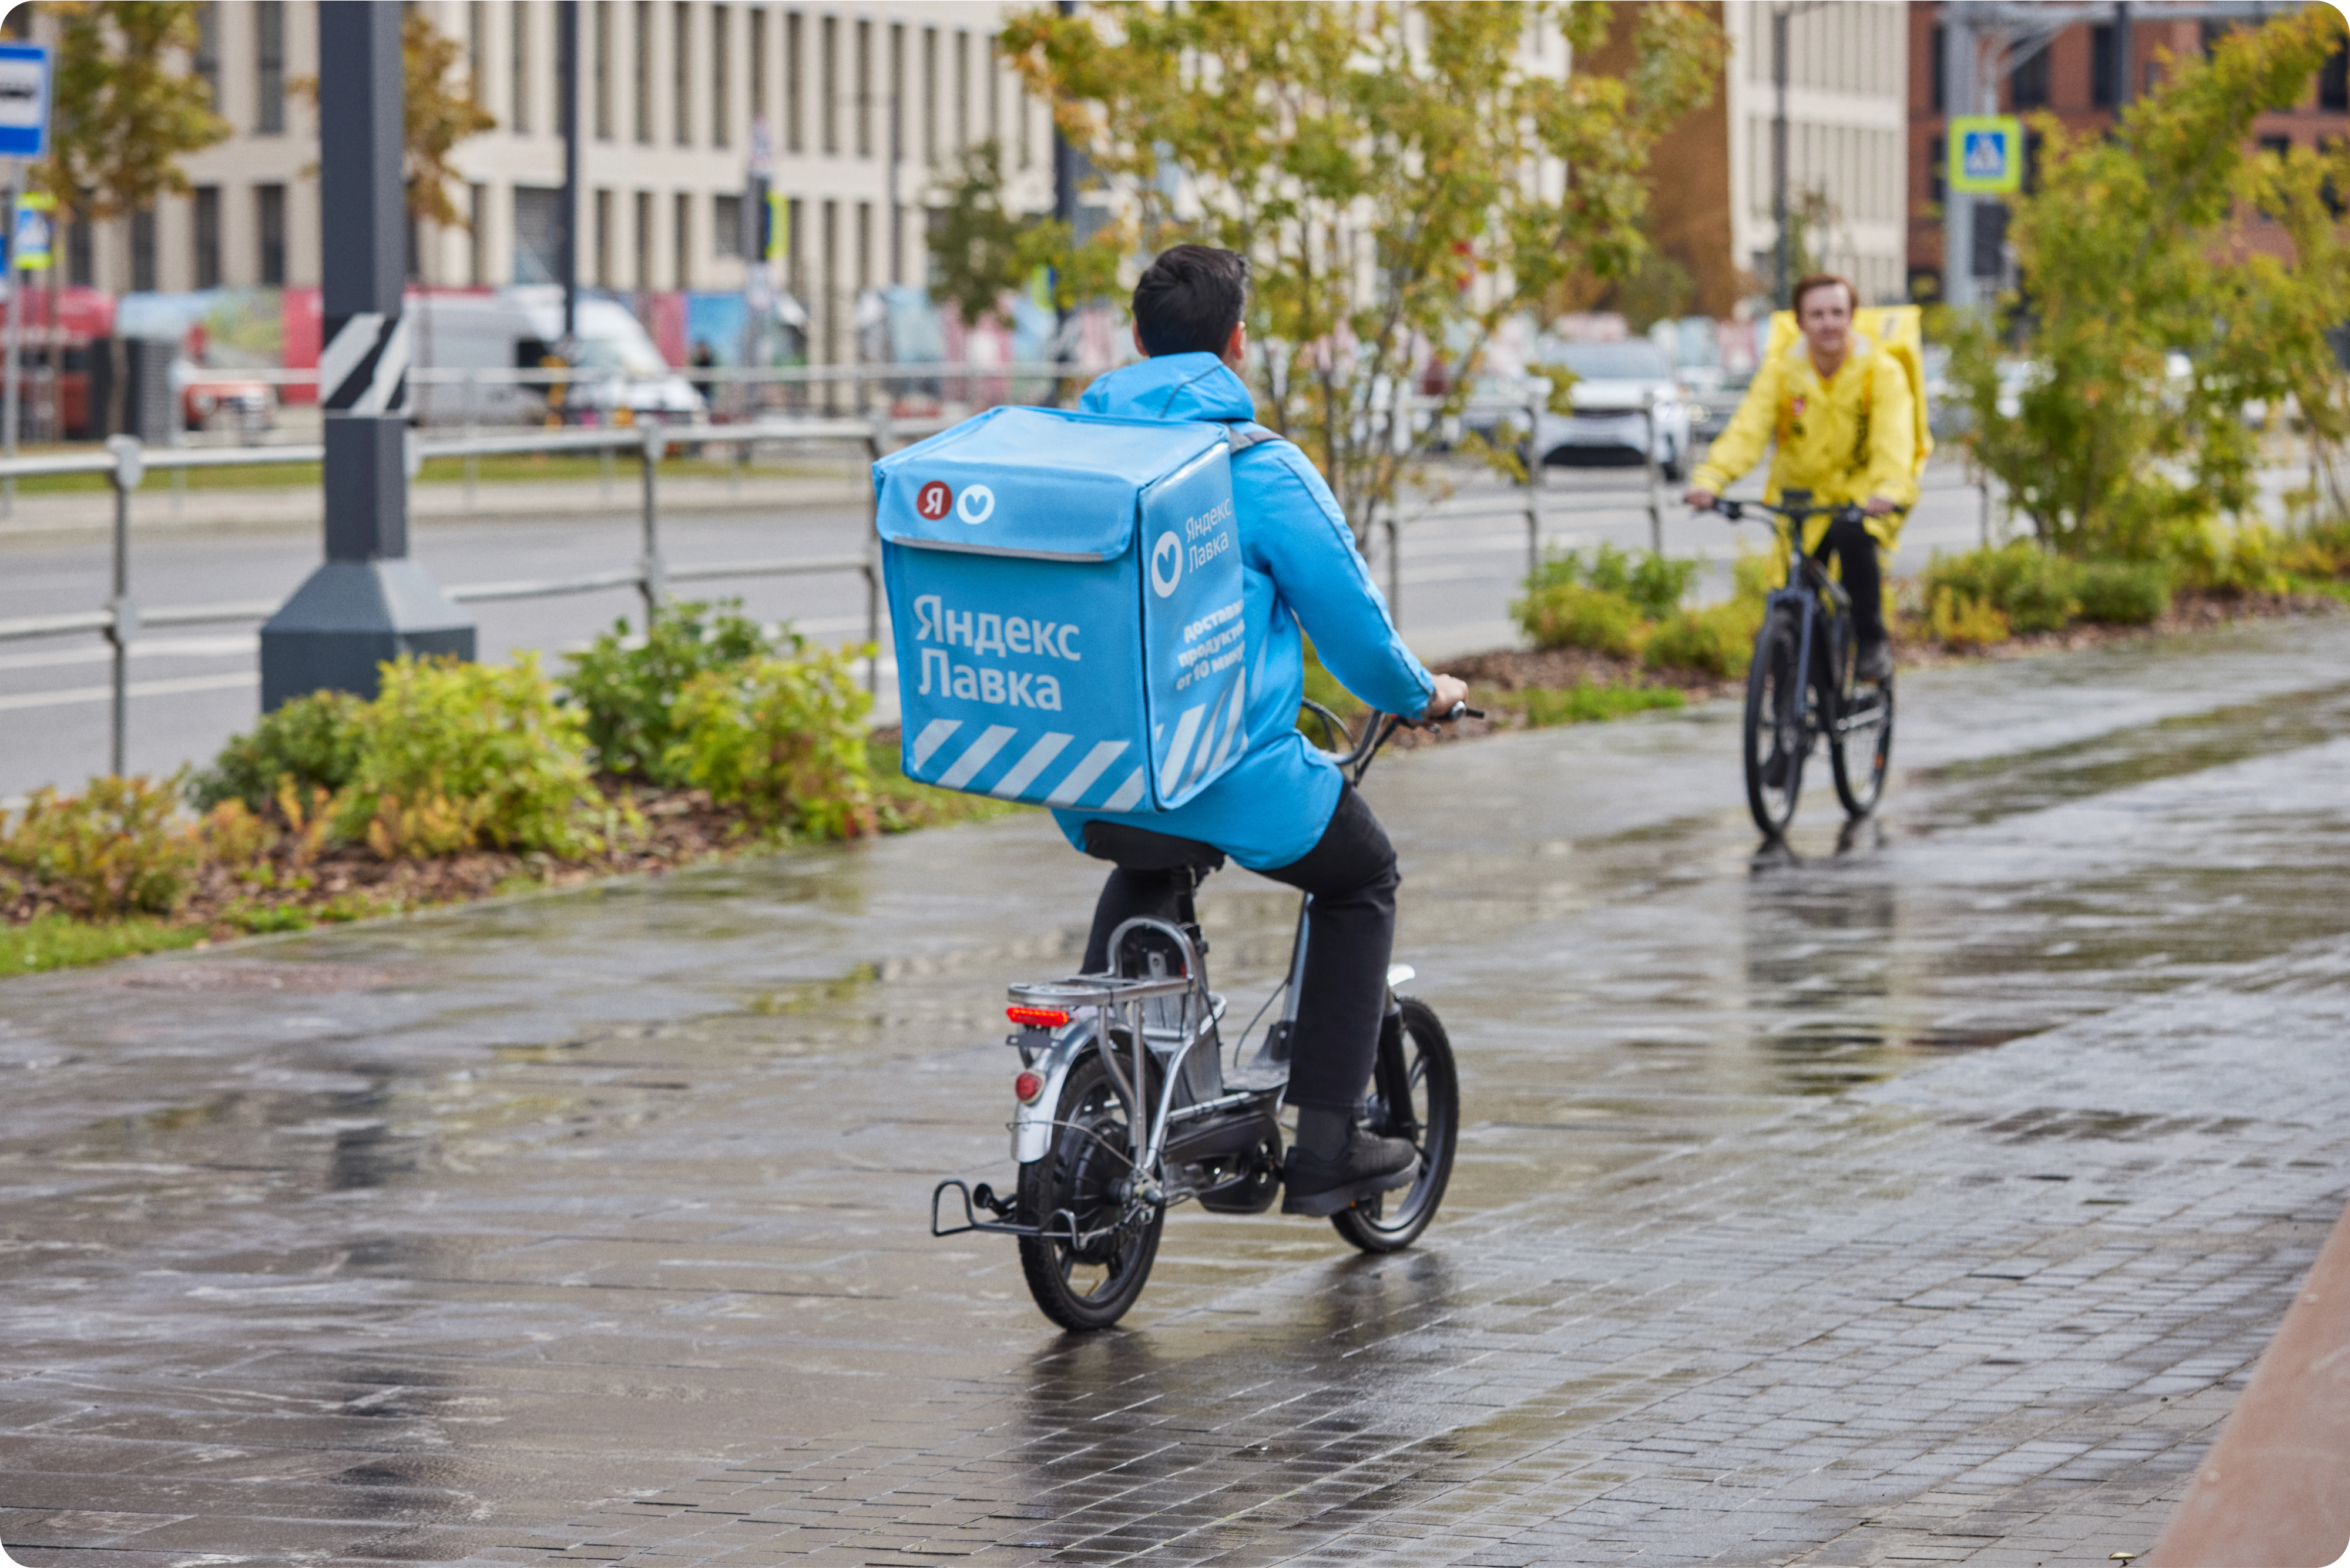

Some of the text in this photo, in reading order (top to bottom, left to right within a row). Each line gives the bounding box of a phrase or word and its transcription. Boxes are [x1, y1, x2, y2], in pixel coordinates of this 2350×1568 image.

[923, 486, 944, 515] Я
[1186, 498, 1232, 543] Яндекс
[1189, 531, 1228, 573] Лавка
[913, 594, 1081, 661] Яндекс
[918, 647, 1062, 711] Лавка
[1176, 673, 1192, 691] от
[1193, 660, 1210, 681] 10
